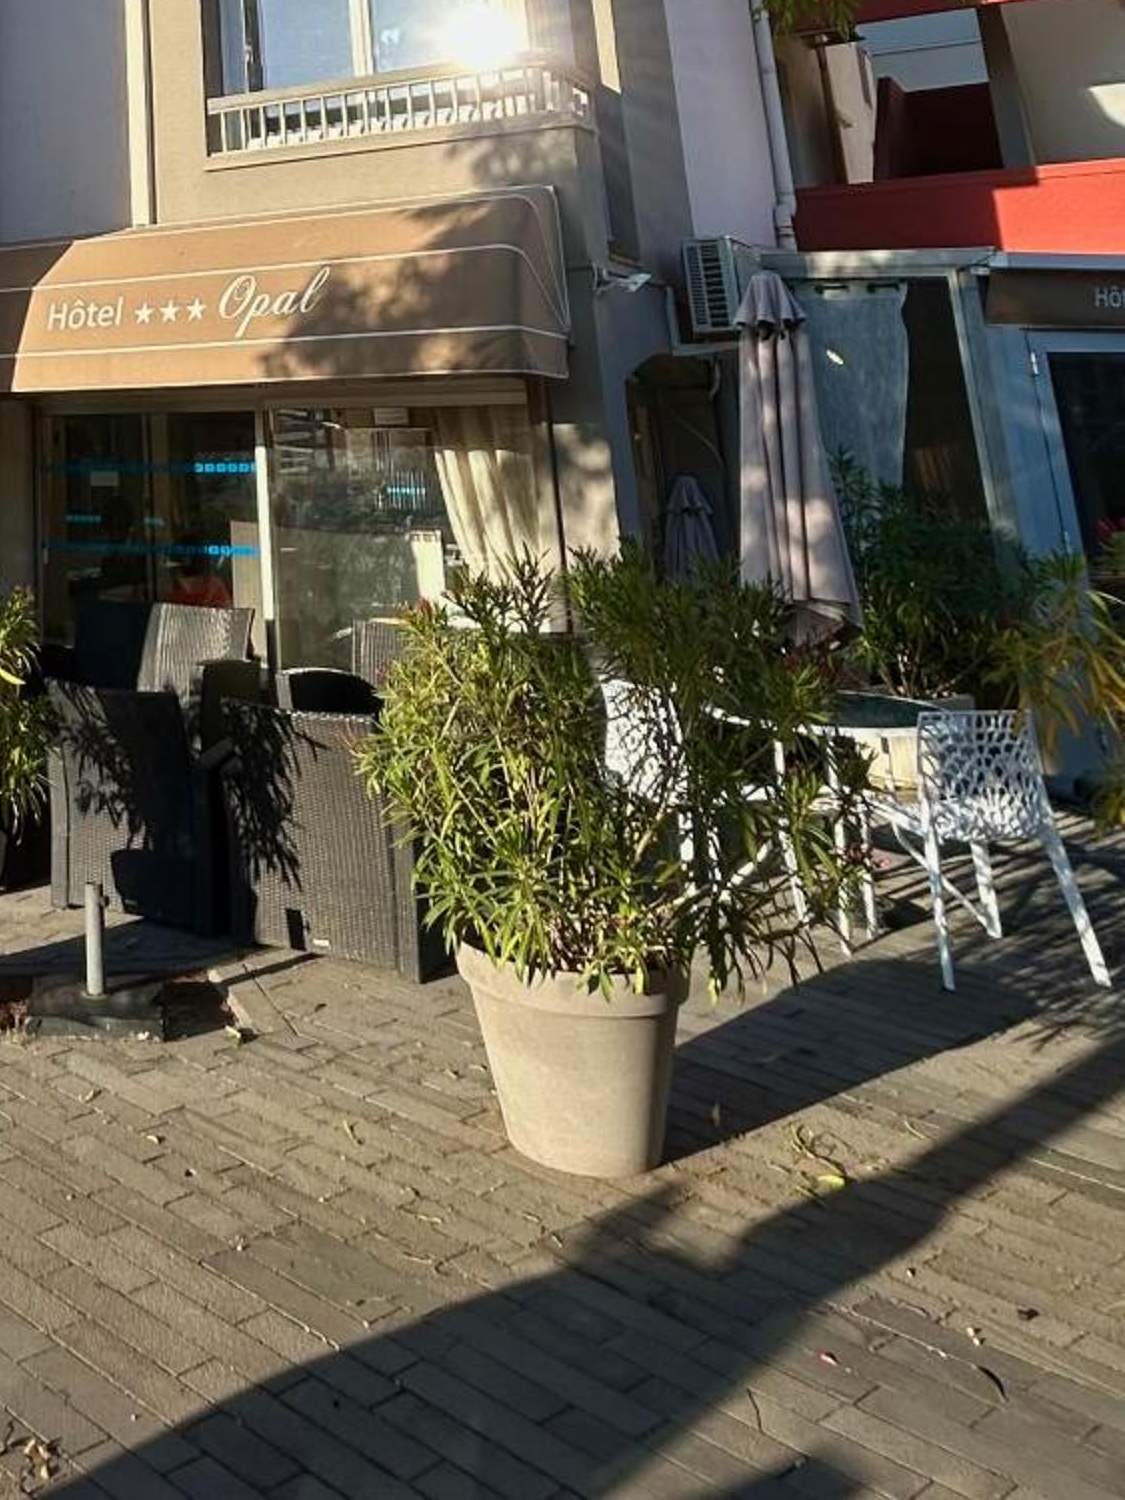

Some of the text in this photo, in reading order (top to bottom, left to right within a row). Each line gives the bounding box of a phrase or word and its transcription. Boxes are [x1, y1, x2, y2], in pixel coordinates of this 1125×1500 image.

[47, 266, 331, 339] Hôtel Opal
[1094, 285, 1125, 309] Hô
